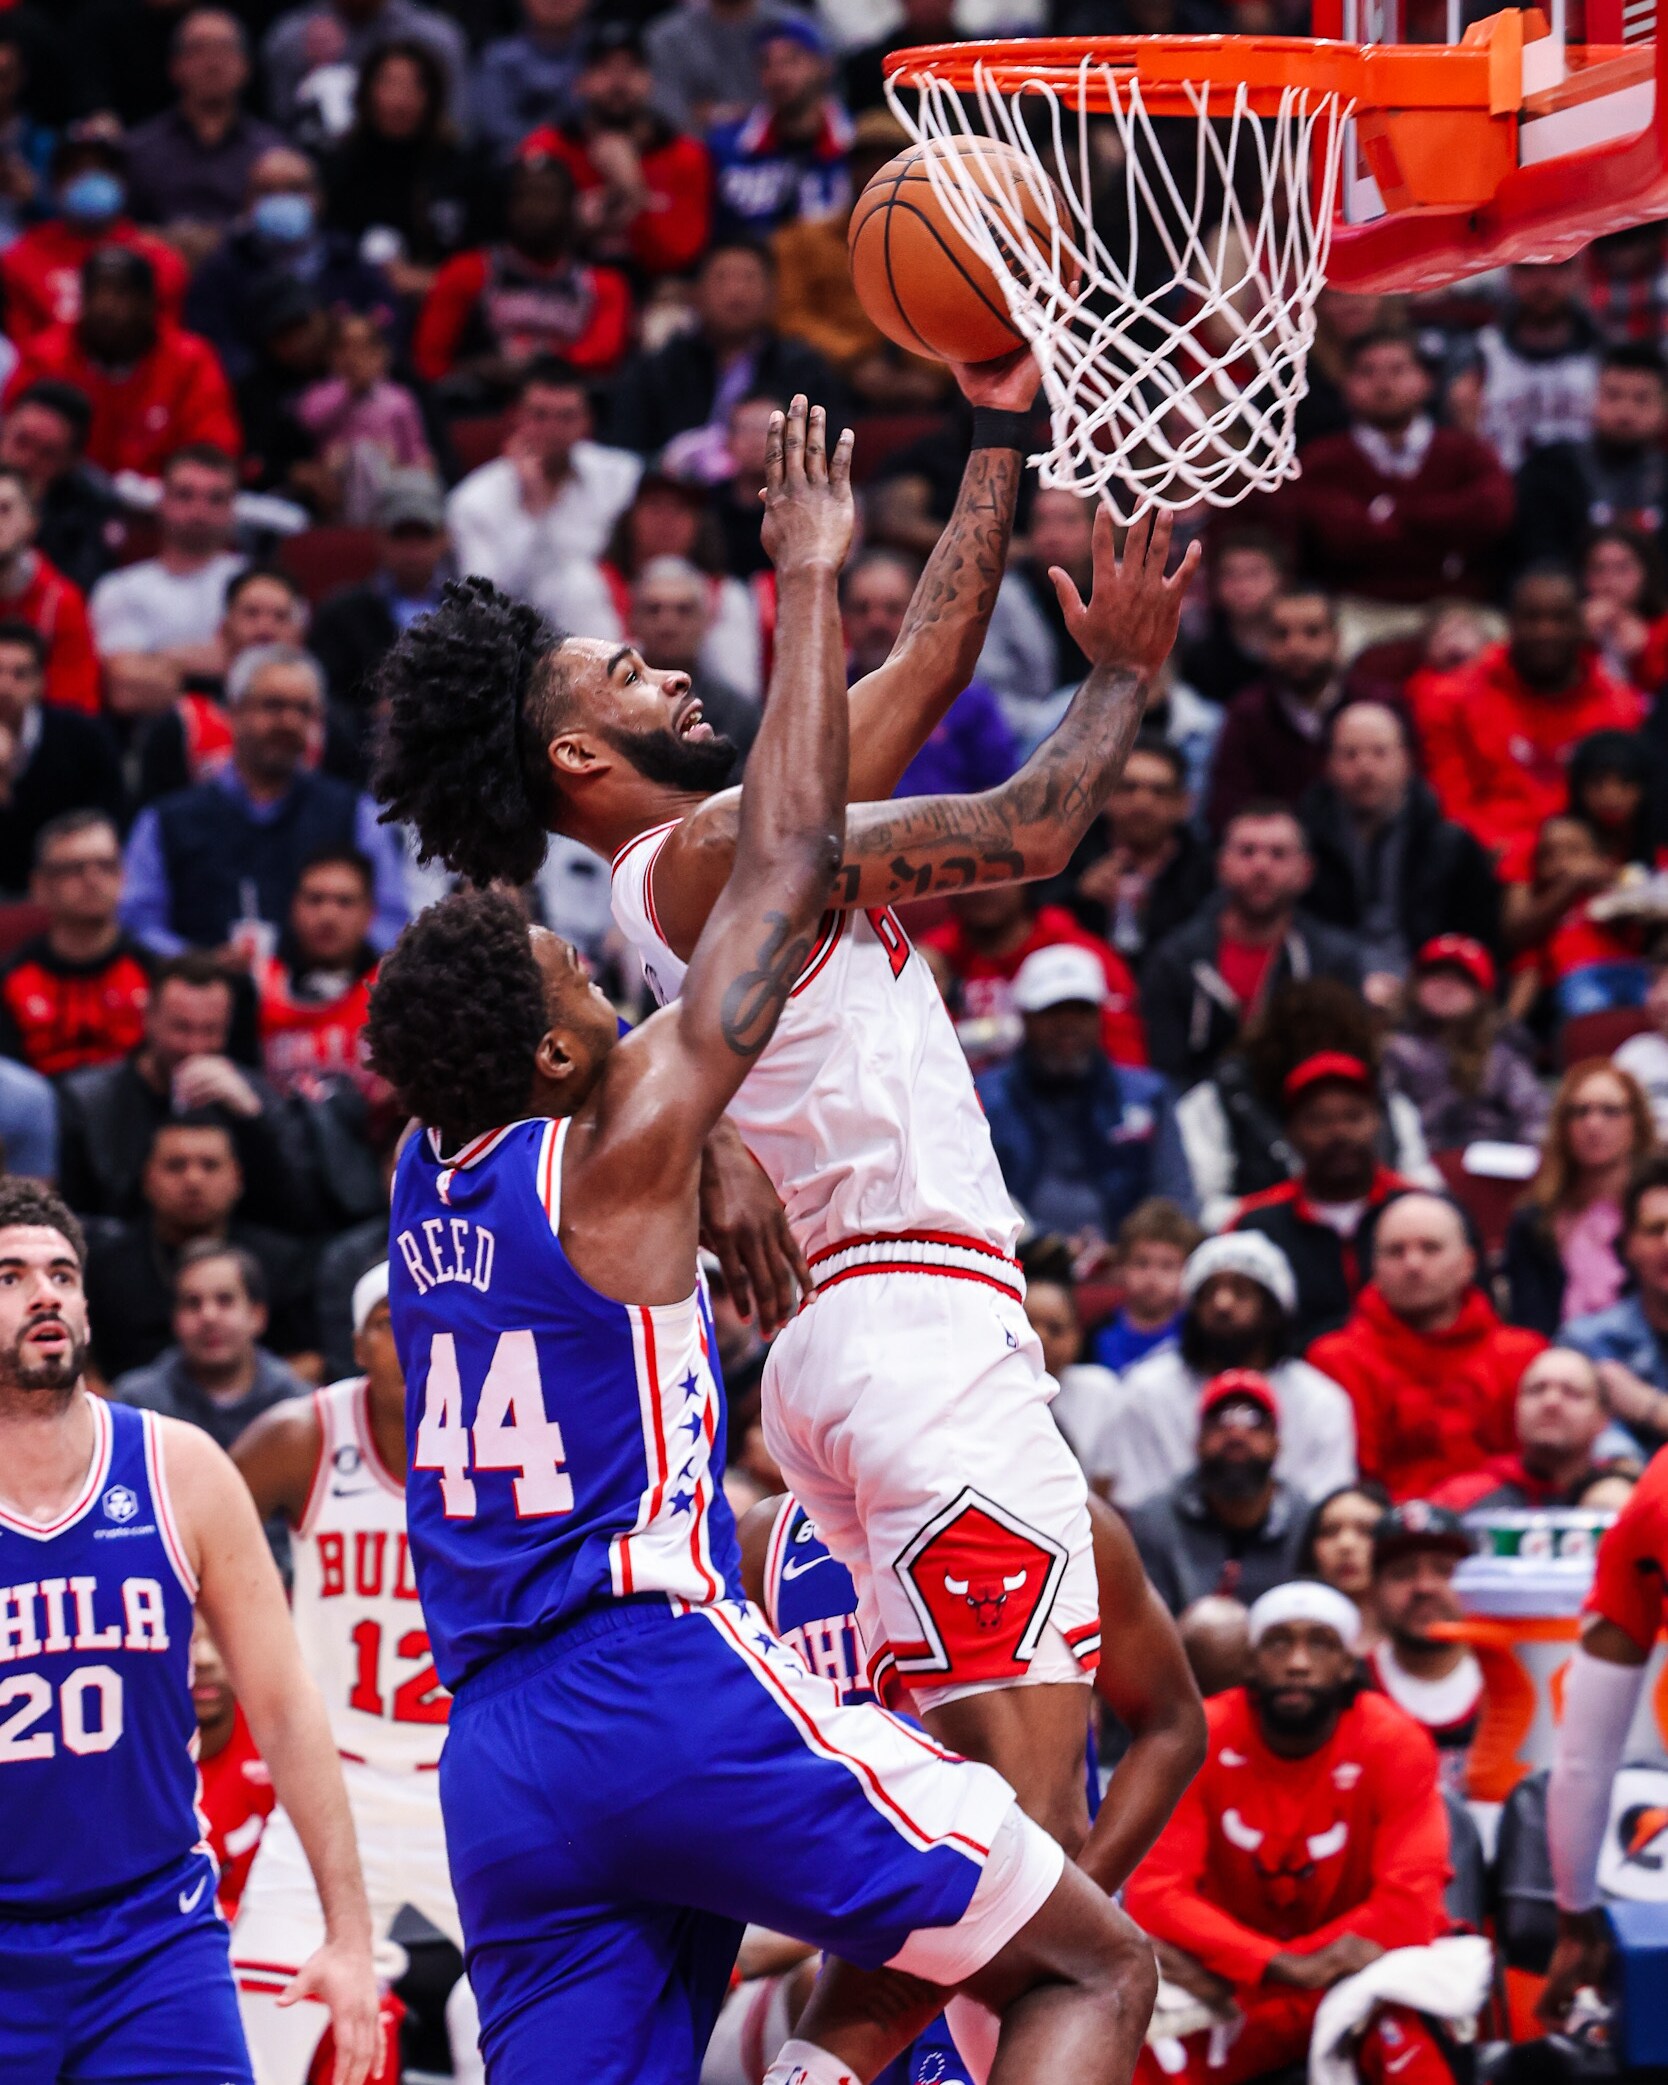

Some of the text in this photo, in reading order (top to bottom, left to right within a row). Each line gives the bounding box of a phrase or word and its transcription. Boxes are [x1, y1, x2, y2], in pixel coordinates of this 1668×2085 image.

[397, 1217, 496, 1296] REED
[413, 1329, 575, 1521] 44
[0, 1664, 124, 1764] 20
[349, 1618, 454, 1725] 12
